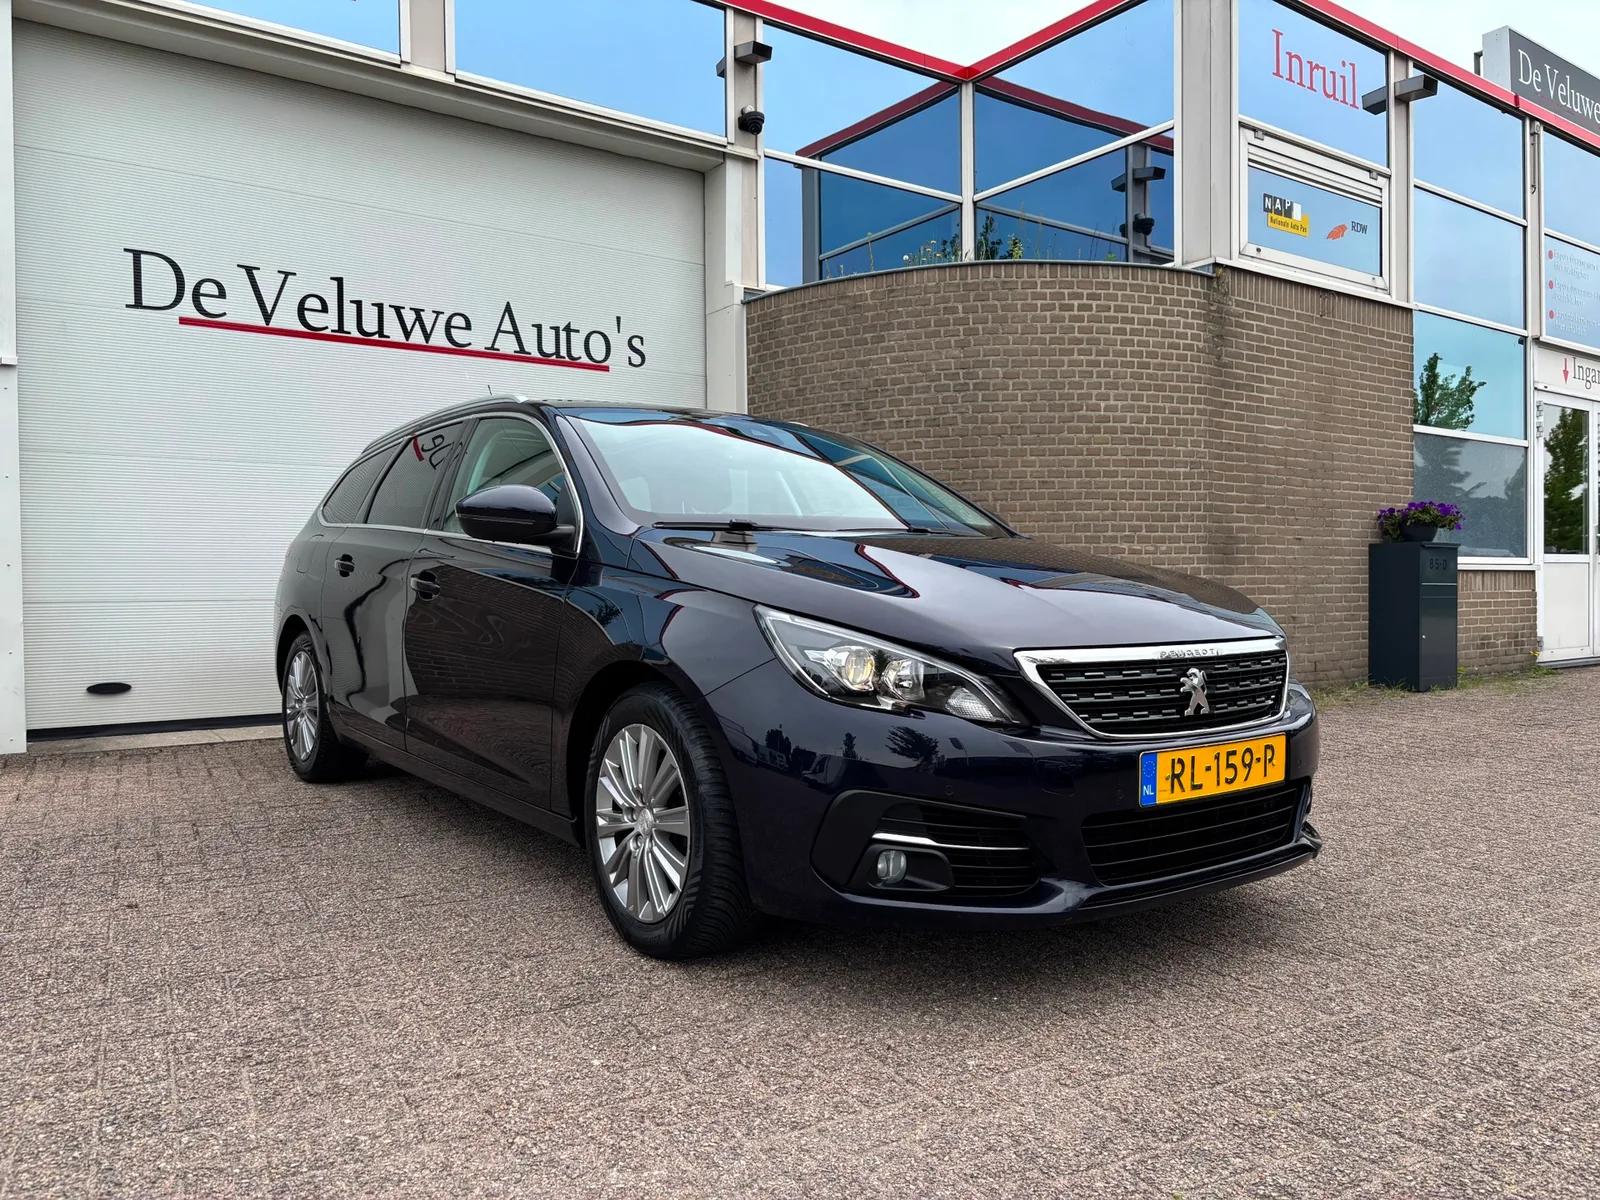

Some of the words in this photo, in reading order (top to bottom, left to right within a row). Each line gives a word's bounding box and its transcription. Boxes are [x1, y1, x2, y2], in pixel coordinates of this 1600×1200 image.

[1272, 29, 1359, 110] Inruil
[1518, 49, 1542, 92] De
[1544, 64, 1600, 124] Veluwe
[1264, 196, 1292, 211] NAP
[1270, 216, 1289, 229] Nationale
[1290, 222, 1299, 231] Auto
[1300, 224, 1308, 233] Pas
[1351, 221, 1368, 235] RDW
[123, 248, 227, 319] De
[237, 264, 472, 348] Veluwe
[484, 300, 646, 368] Auto's
[1159, 648, 1215, 659] PEUGEOT
[1170, 744, 1275, 794] RL-159-P
[1143, 784, 1154, 796] NL
